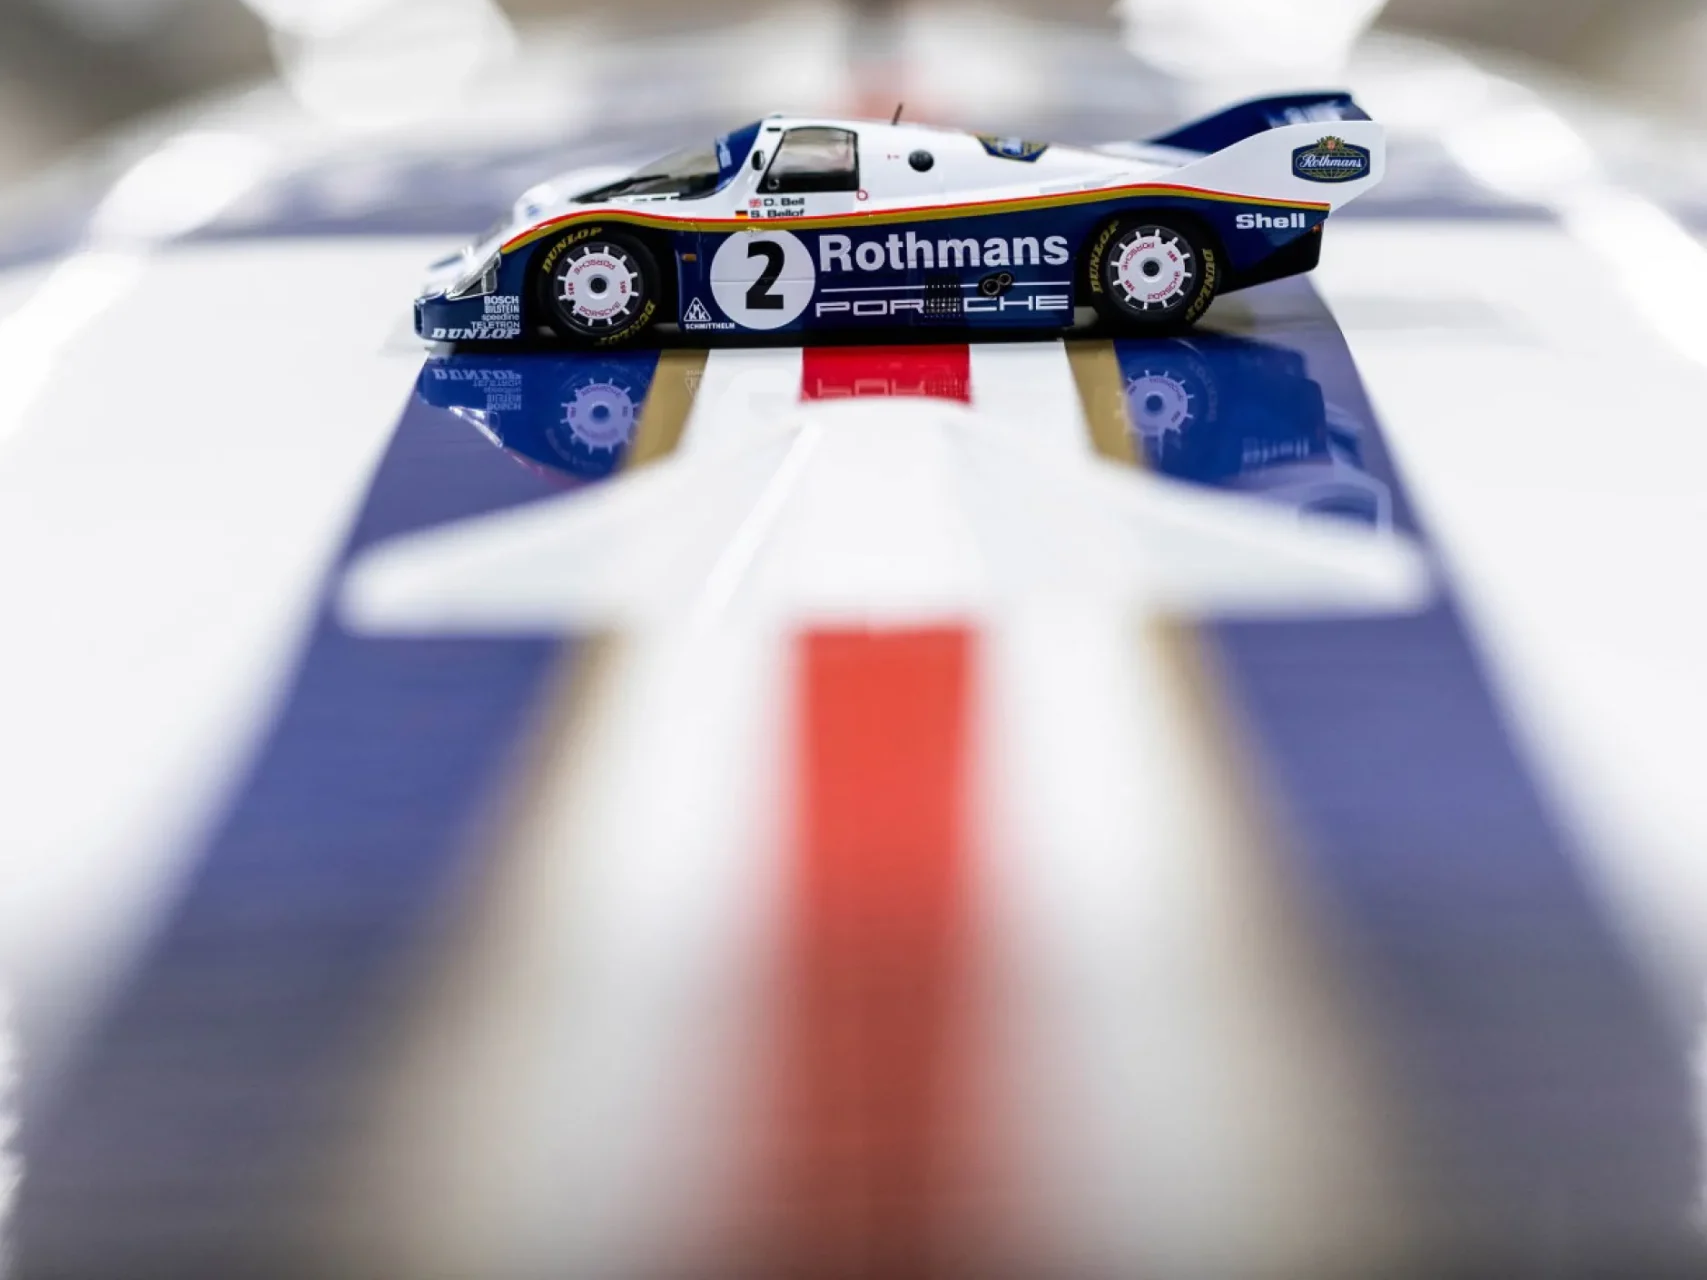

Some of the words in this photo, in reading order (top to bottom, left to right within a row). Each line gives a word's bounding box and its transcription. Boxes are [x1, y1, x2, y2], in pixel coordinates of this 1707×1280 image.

[1300, 154, 1362, 168] Rothmans
[781, 198, 805, 206] Bell
[767, 209, 805, 218] Bellof
[1235, 213, 1306, 230] Shell
[542, 227, 602, 273] DUNLOP
[818, 231, 1069, 272] Rothmans
[1089, 220, 1119, 293] DUNLOP
[1121, 242, 1155, 271] PORSCHE
[573, 259, 616, 275] PORSCHE
[745, 240, 785, 310] 2
[1147, 271, 1180, 300] PORSCHE
[483, 295, 519, 304] BOSCH
[484, 304, 520, 313] BILSTEIN
[579, 301, 621, 317] PORSCHE
[470, 321, 520, 329] TELETRON
[431, 328, 521, 339] DUNLOP
